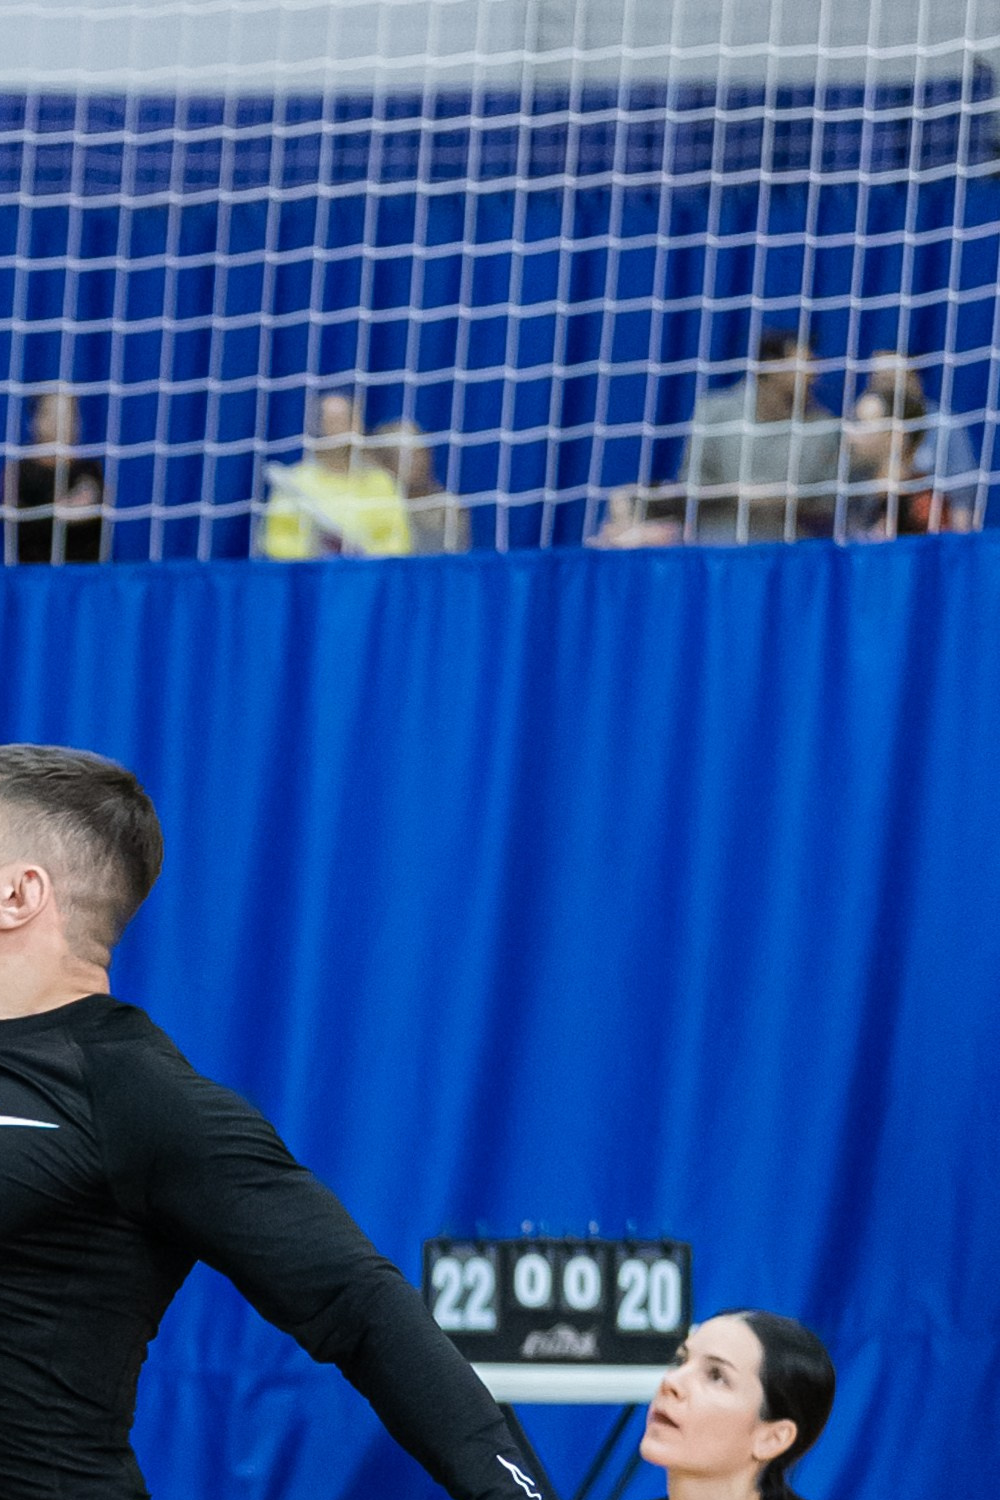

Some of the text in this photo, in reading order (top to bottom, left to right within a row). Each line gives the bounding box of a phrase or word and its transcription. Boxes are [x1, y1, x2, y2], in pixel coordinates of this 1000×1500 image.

[432, 1253, 682, 1333] 22 0 0 20
